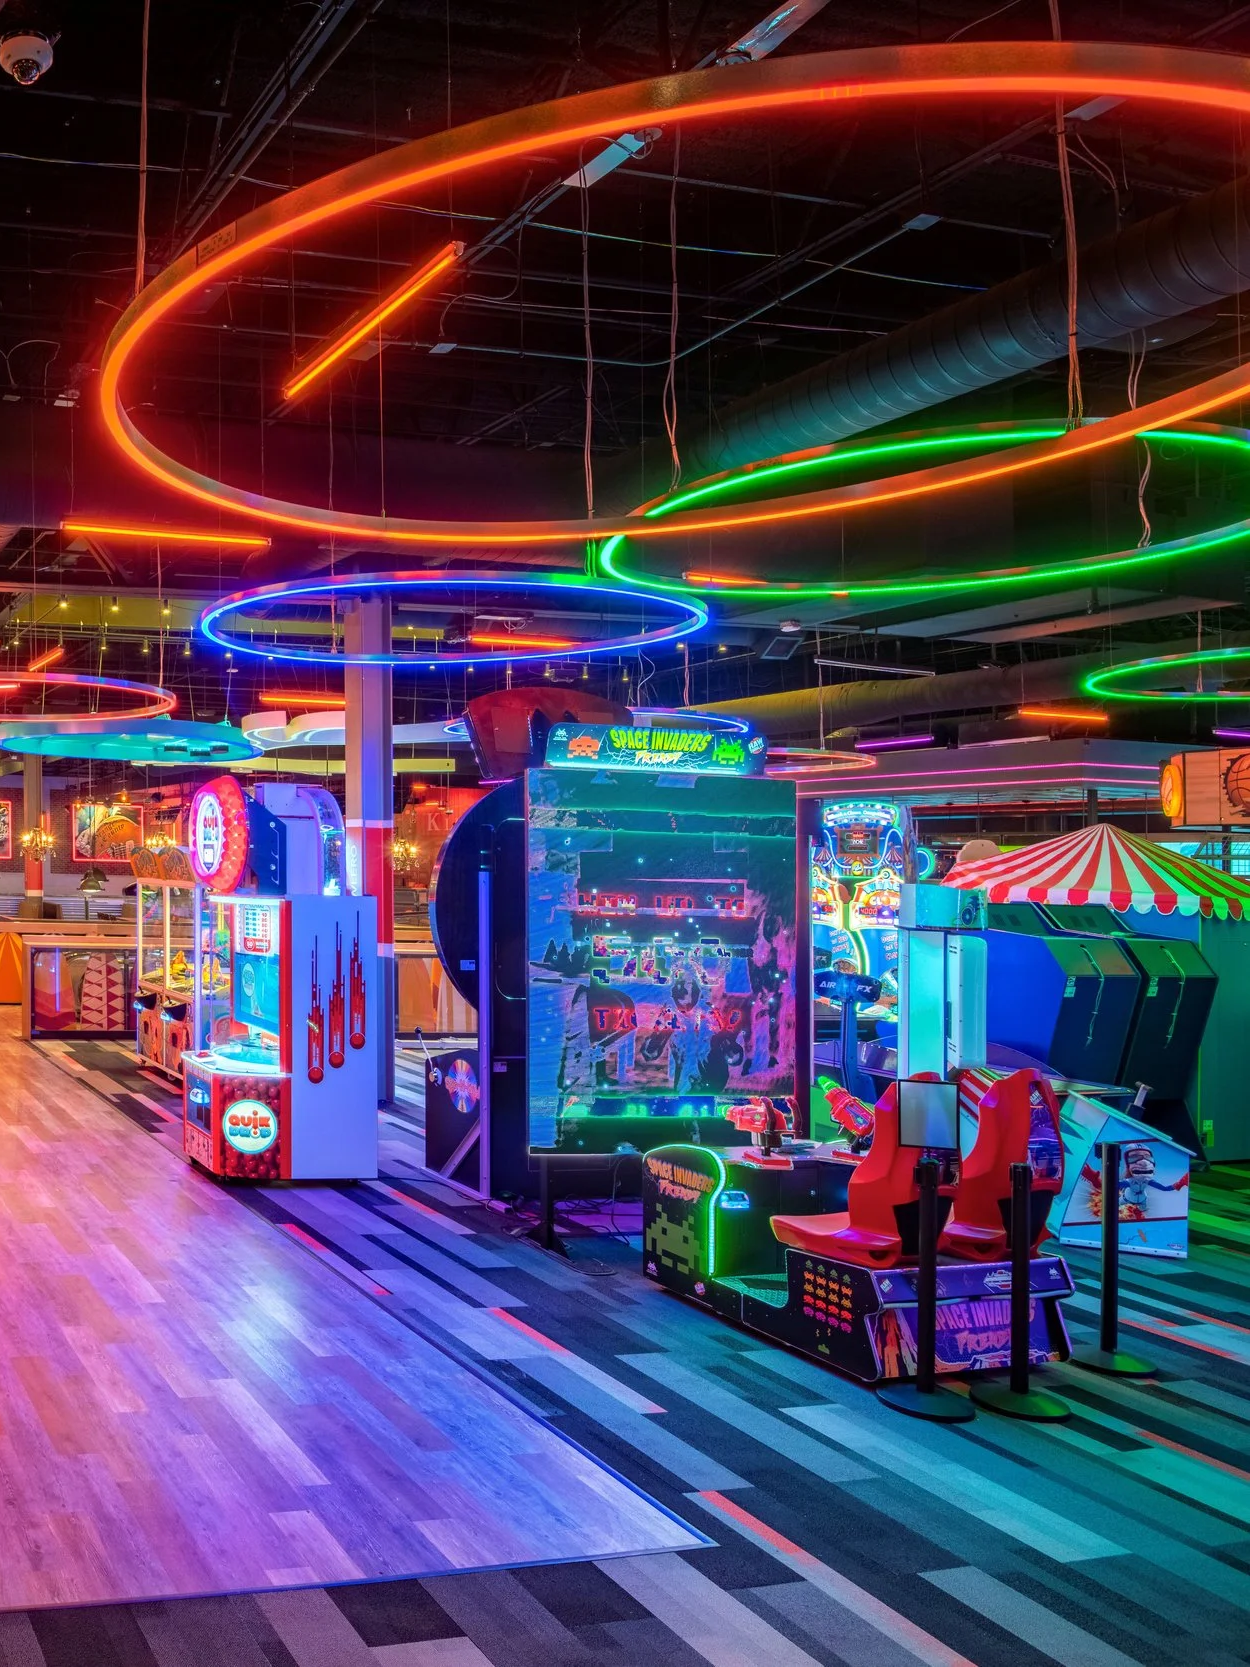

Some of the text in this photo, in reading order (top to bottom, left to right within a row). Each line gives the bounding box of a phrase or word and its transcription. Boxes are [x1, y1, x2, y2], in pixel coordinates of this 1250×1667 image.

[610, 728, 712, 753] SPACE INVADERS
[819, 980, 873, 993] AIR FX
[646, 1157, 715, 1193] SPACE INVADERS
[970, 1299, 1037, 1327] INVADS
[954, 1328, 1012, 1355] FRENZ
